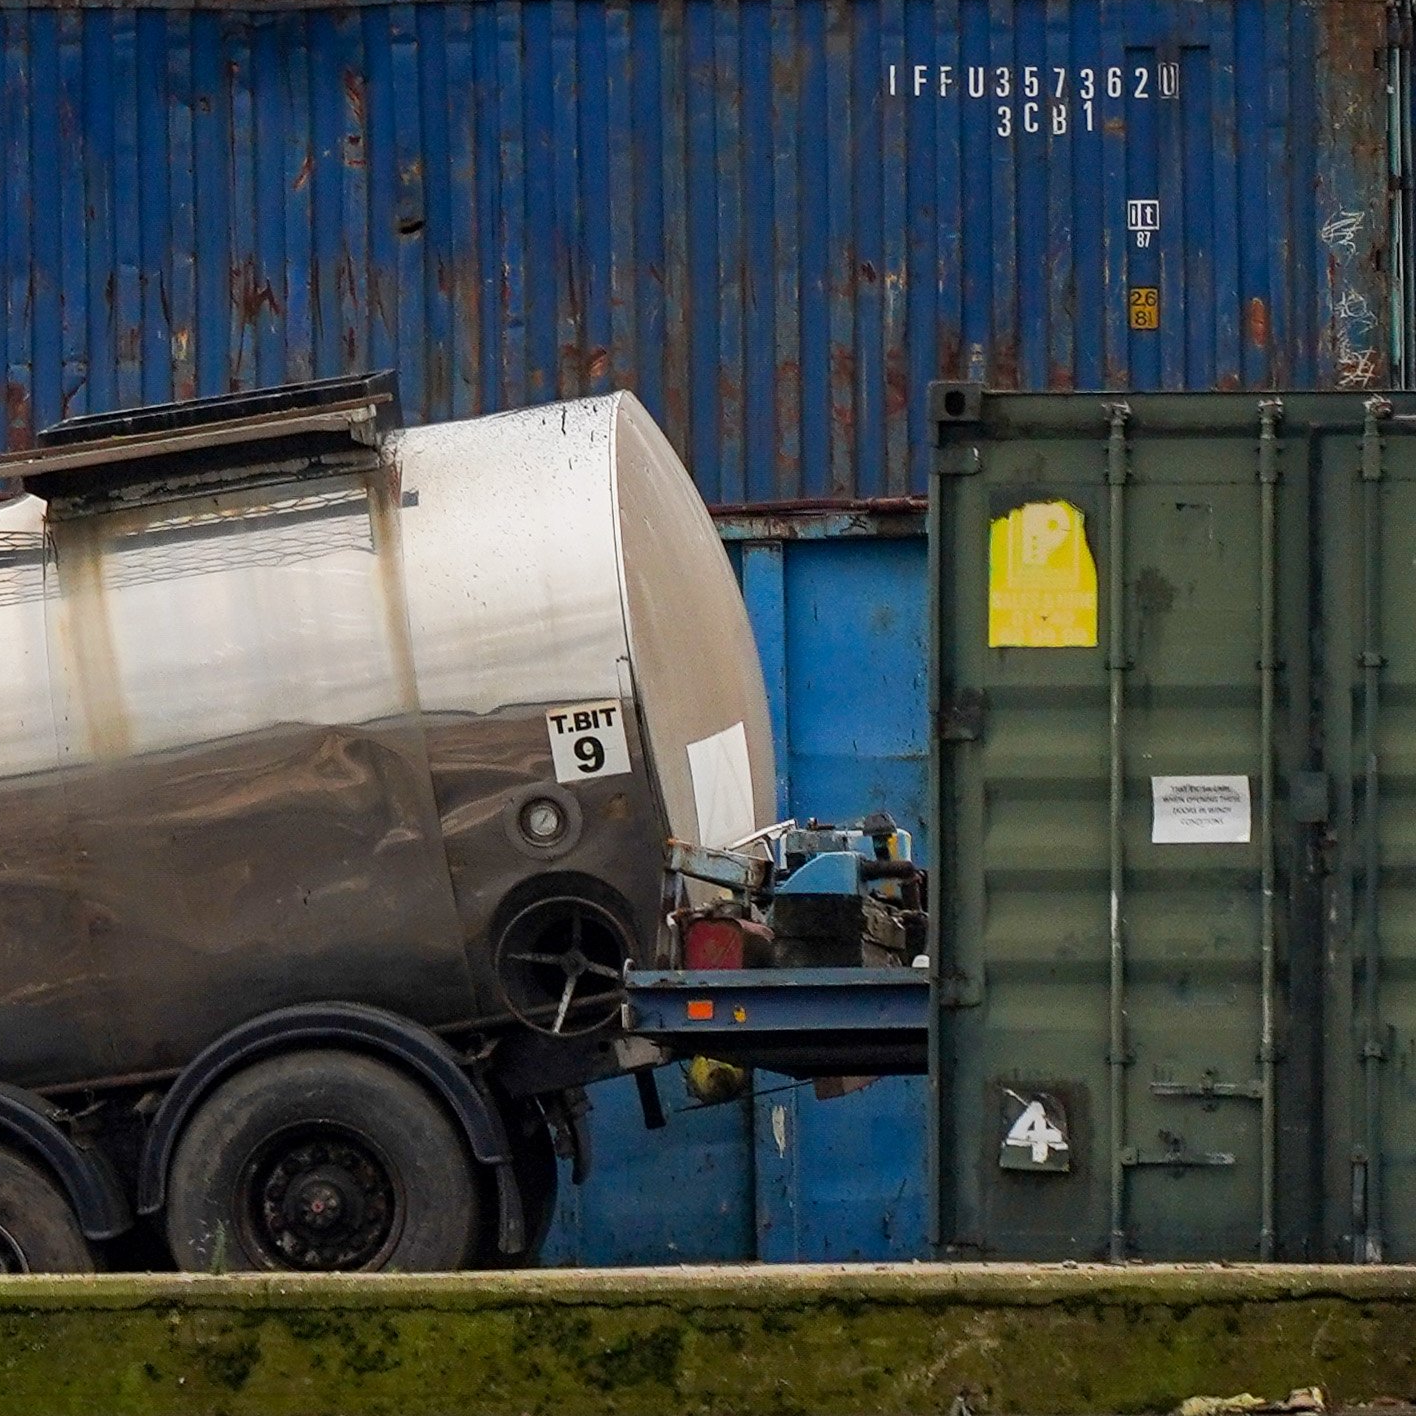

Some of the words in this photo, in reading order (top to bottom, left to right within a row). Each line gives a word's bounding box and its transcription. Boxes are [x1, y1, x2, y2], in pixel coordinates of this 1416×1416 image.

[1136, 231, 1151, 248] 87
[549, 707, 616, 734] T.BIT
[573, 735, 606, 774] 9
